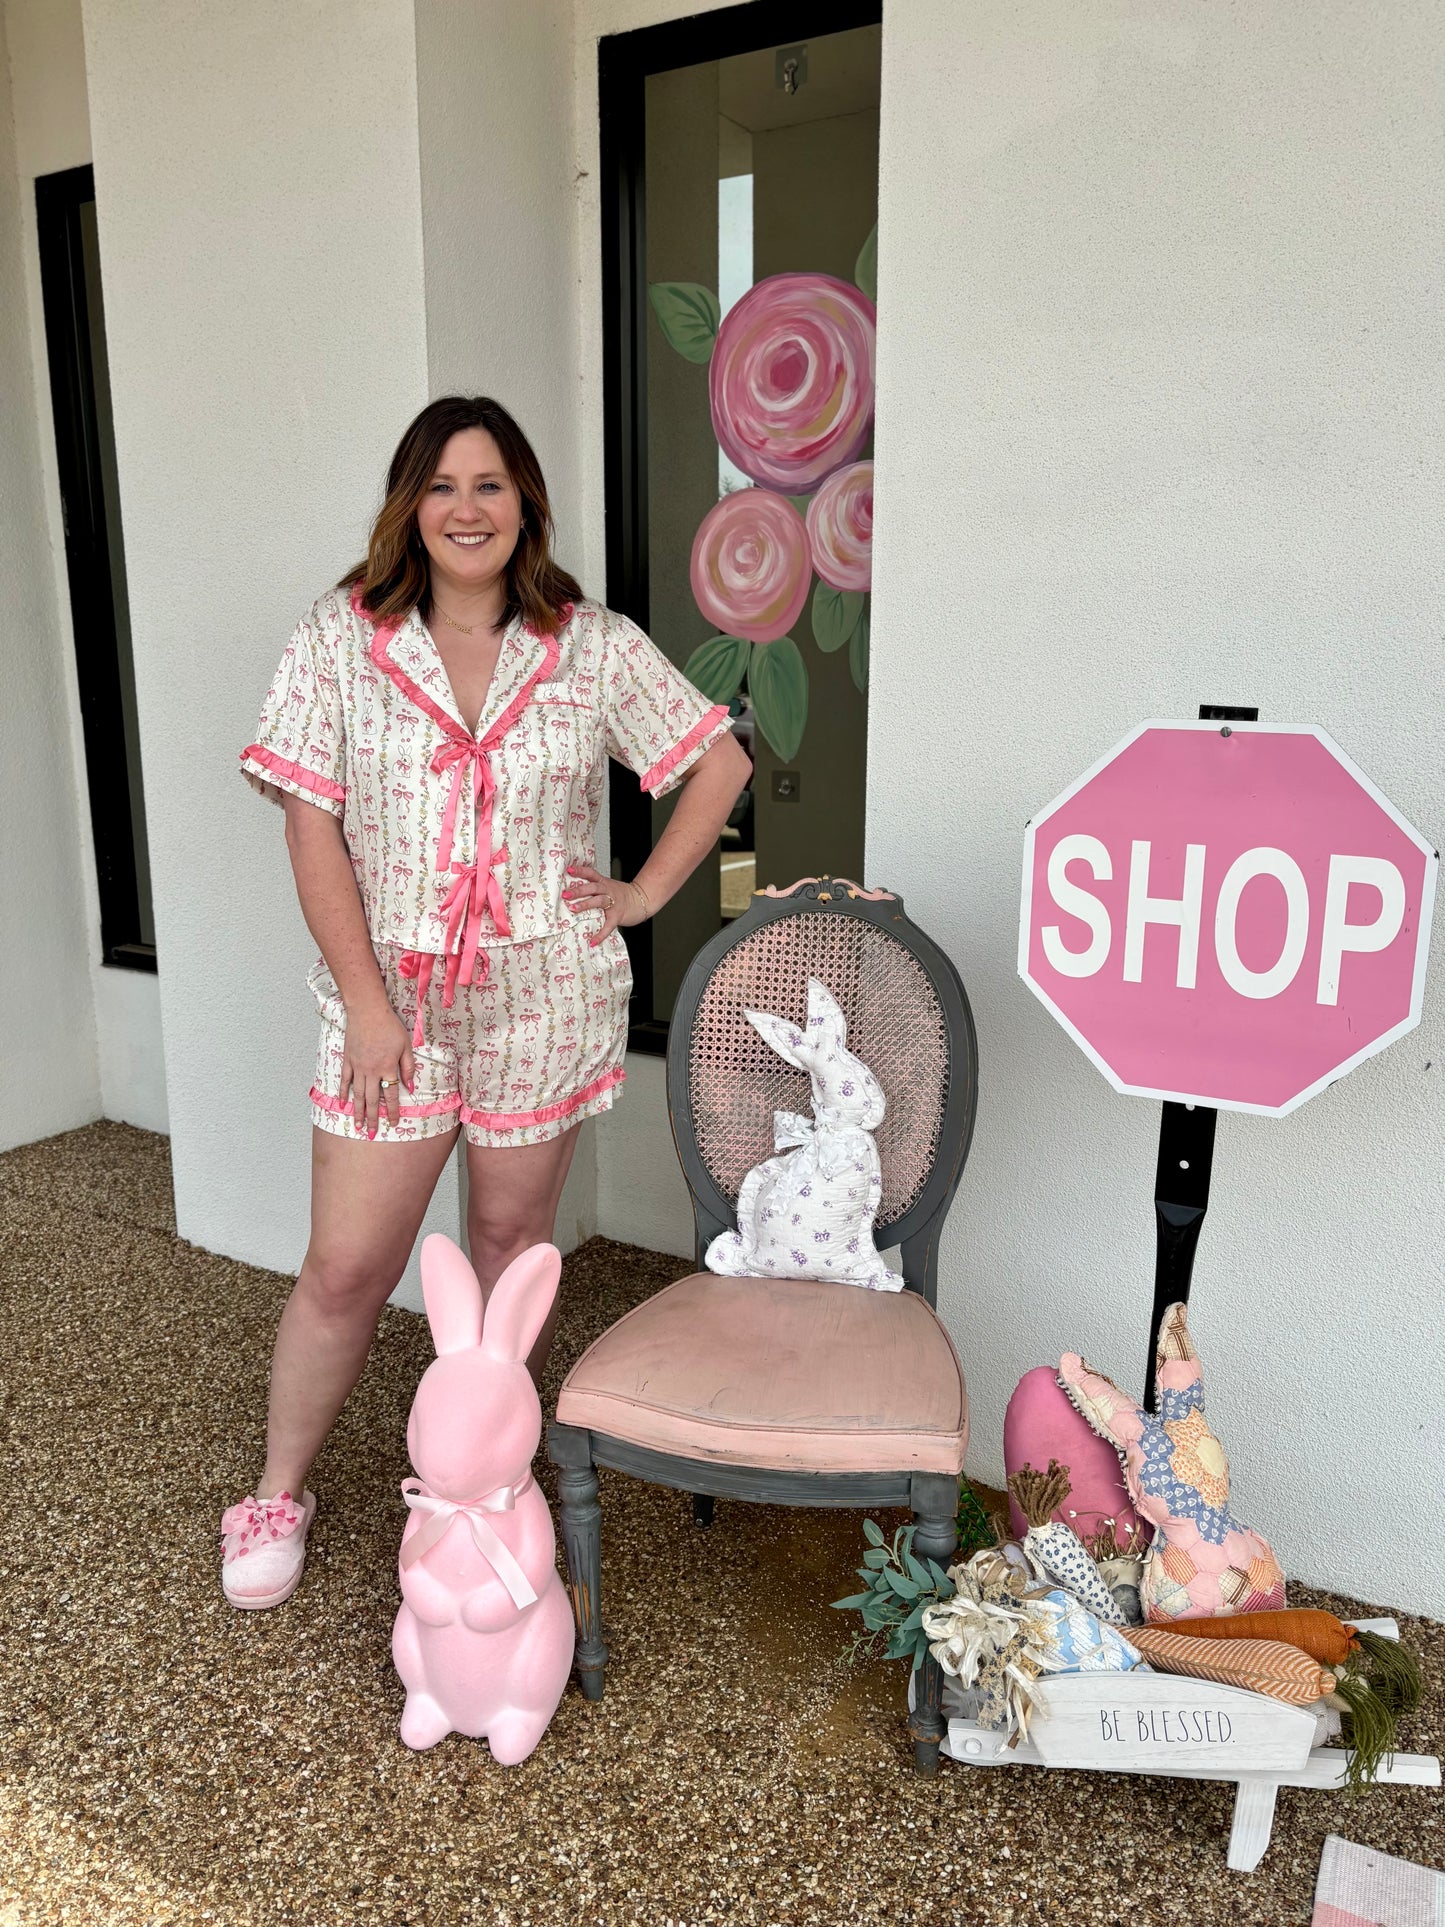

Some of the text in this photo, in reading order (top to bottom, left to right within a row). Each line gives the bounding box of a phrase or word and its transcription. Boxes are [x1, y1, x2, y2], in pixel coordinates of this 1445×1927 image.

[1041, 834, 1406, 1006] SHOP
[1100, 1709, 1236, 1743] BE BLESSED.
